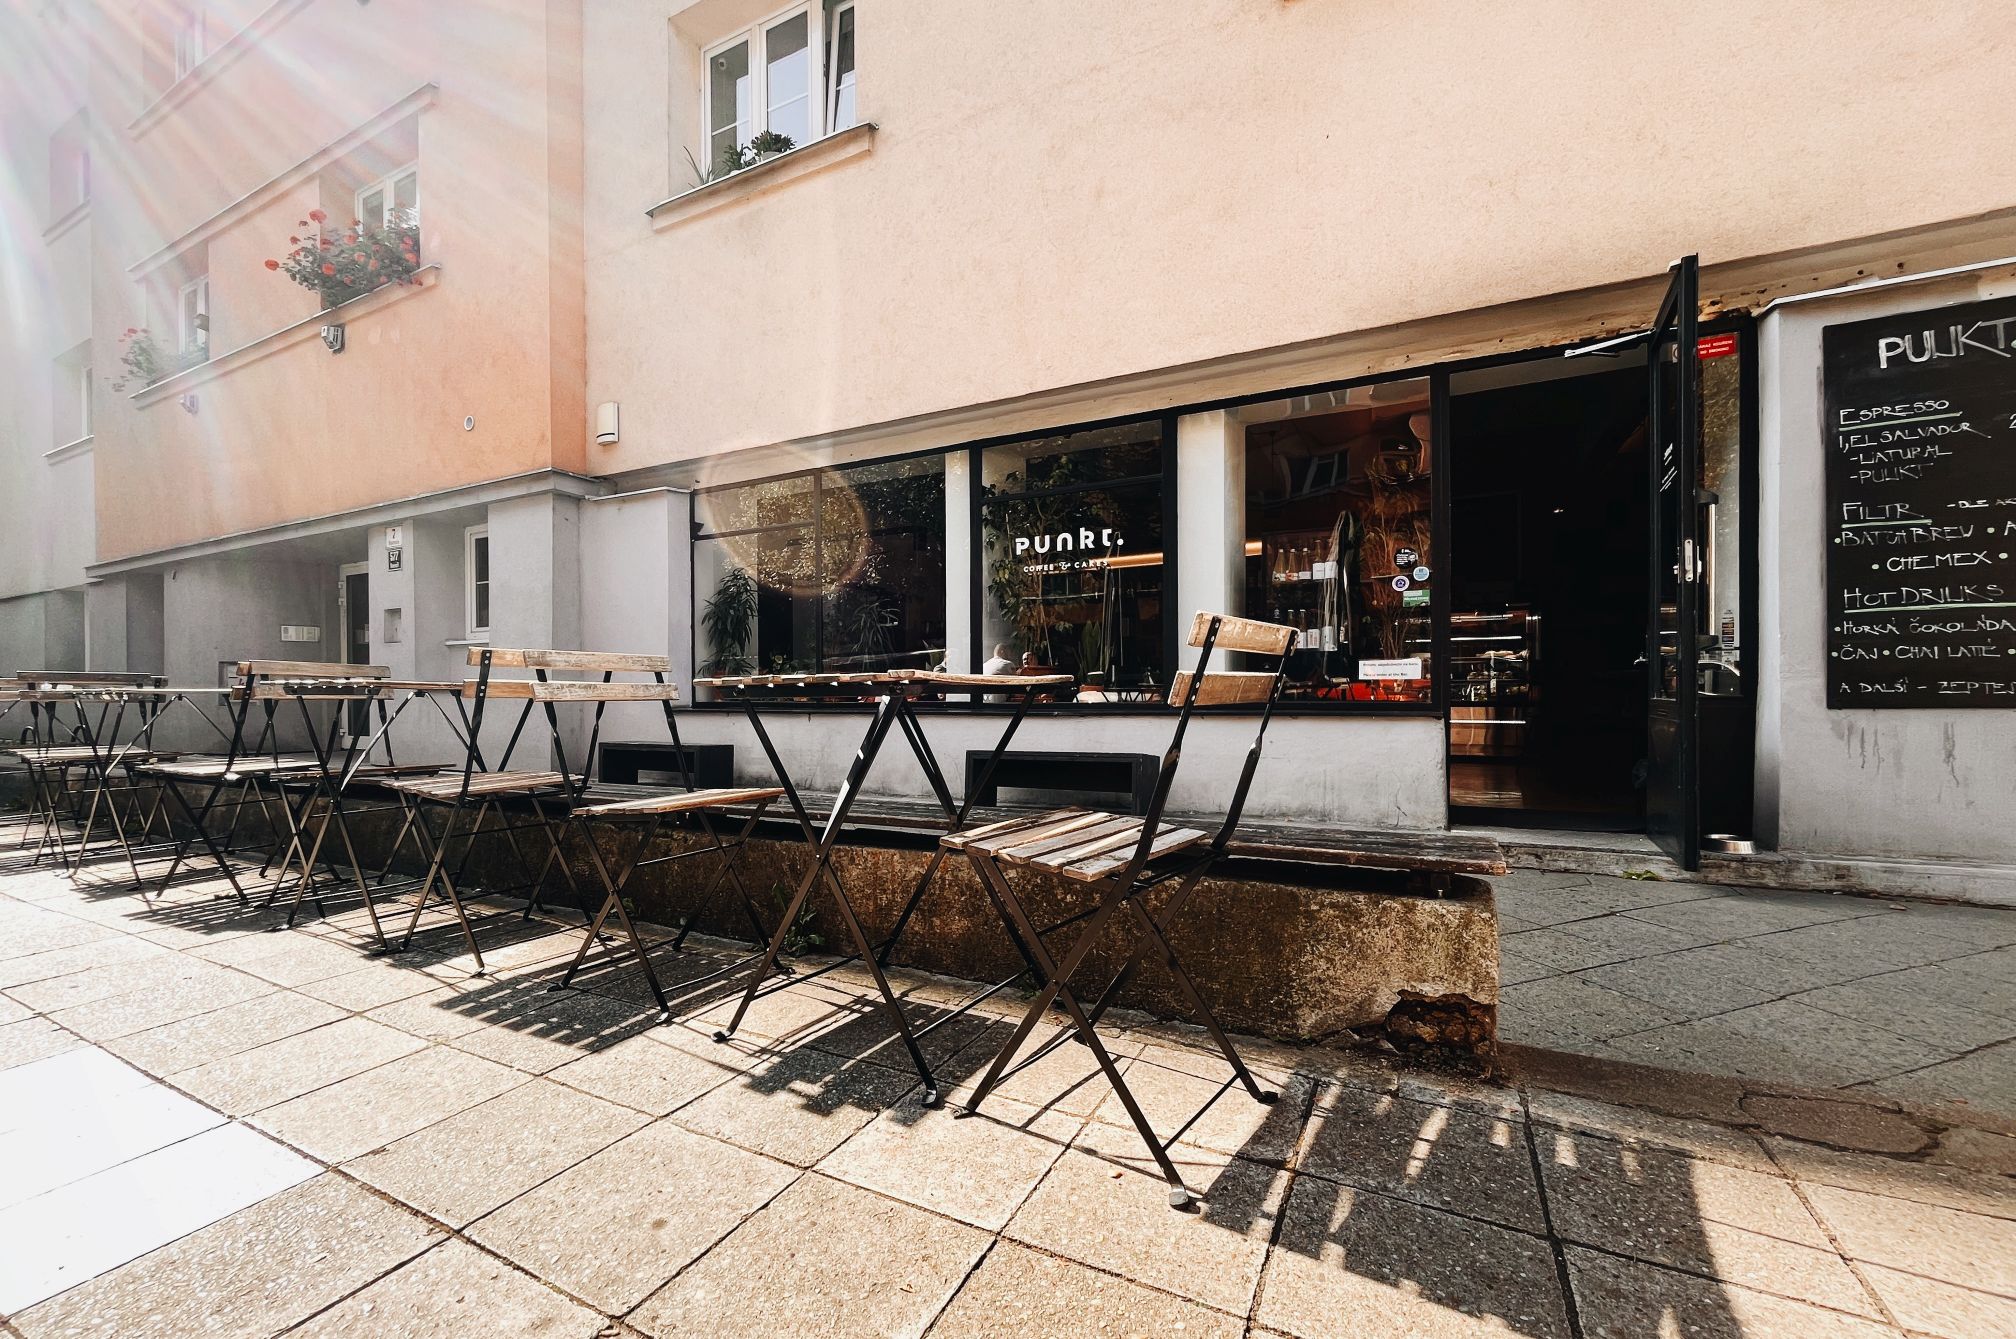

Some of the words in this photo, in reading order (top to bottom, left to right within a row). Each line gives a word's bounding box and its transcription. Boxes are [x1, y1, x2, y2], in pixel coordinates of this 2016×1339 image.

[1840, 400, 1950, 425] ESPRESSO
[1880, 422, 1992, 443] SALVADOR
[1842, 502, 1925, 521] FILTR
[1023, 563, 1054, 573] COFFEE
[1074, 559, 1108, 569] CAKES
[1886, 551, 1992, 572] CHEMEX
[1843, 587, 1897, 608] HOT
[1840, 644, 1878, 660] ČAJ
[1895, 645, 1939, 659] CHAI
[1839, 682, 1851, 693] A
